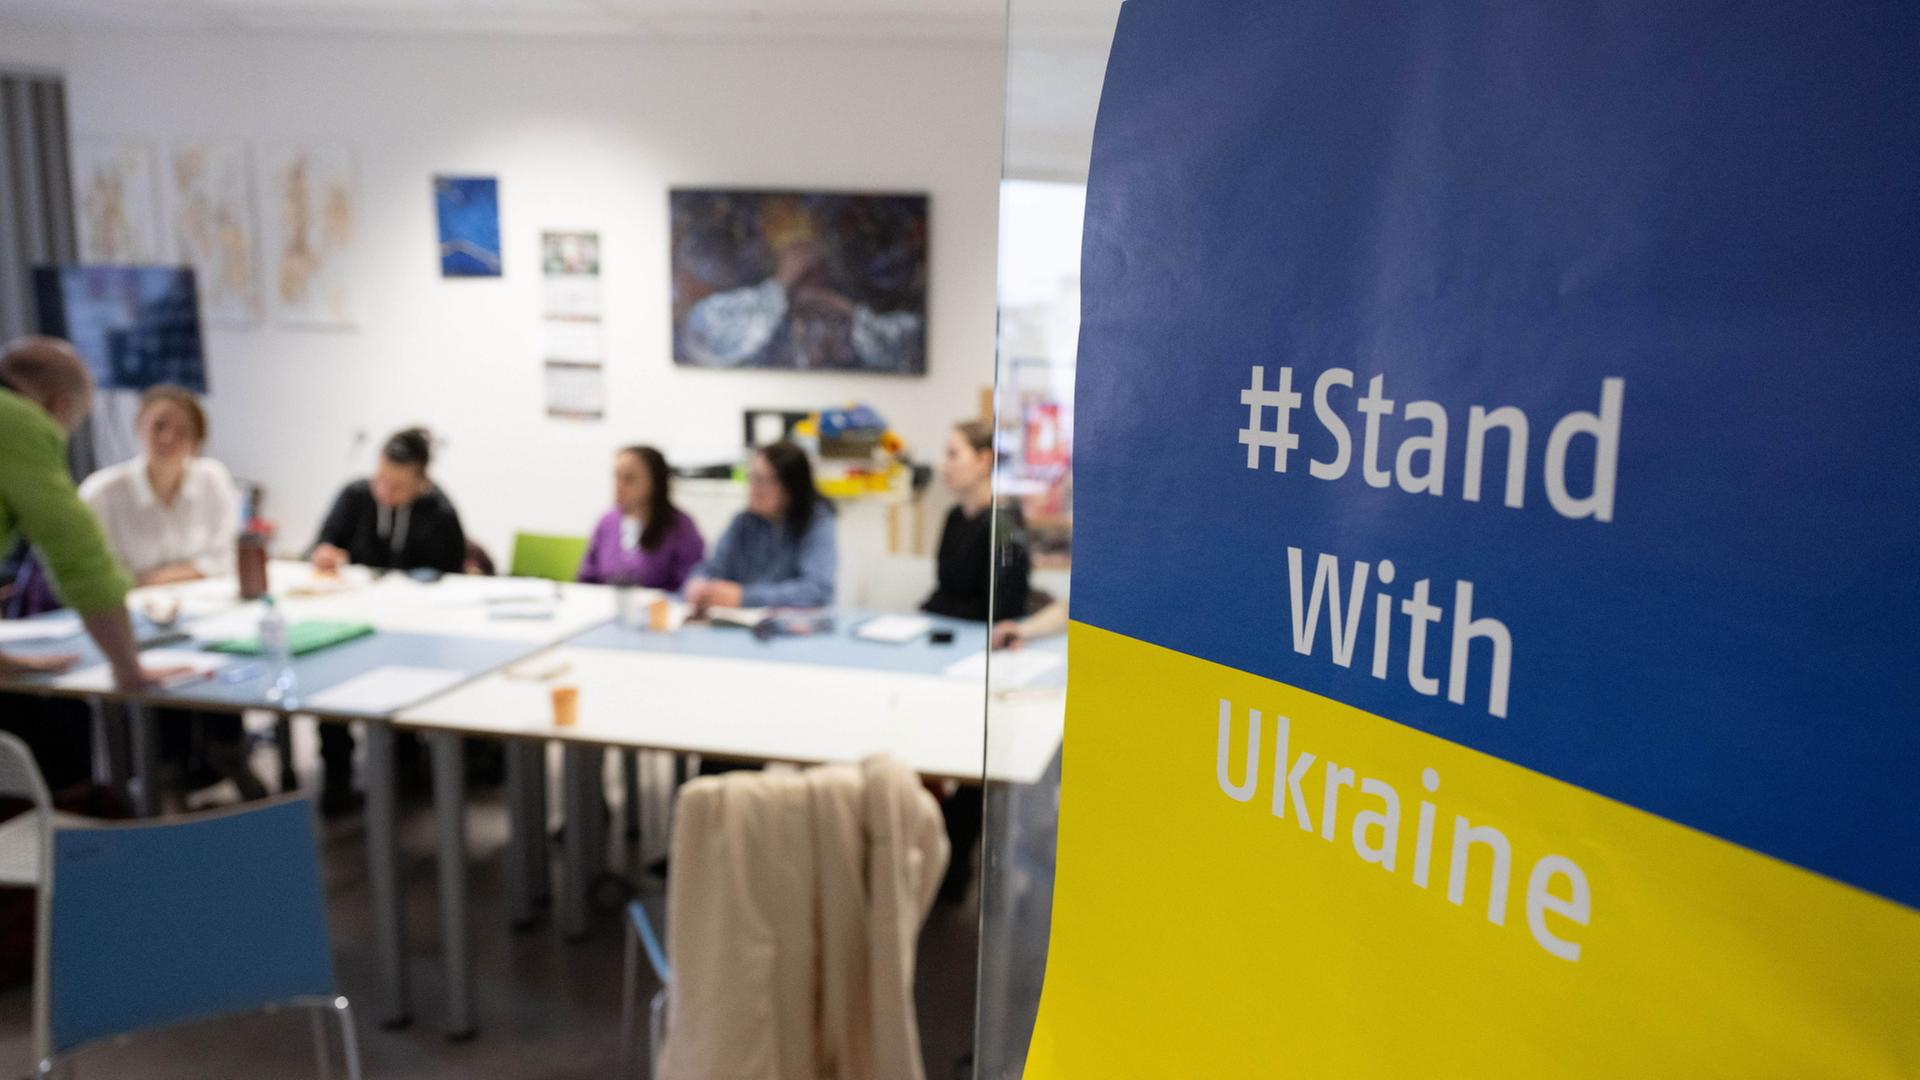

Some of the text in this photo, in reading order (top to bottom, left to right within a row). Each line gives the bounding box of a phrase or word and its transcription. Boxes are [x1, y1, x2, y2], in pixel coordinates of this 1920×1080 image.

[1238, 365, 1625, 522] #Stand
[1287, 546, 1512, 718] With
[1216, 699, 1591, 962] Ukraine
